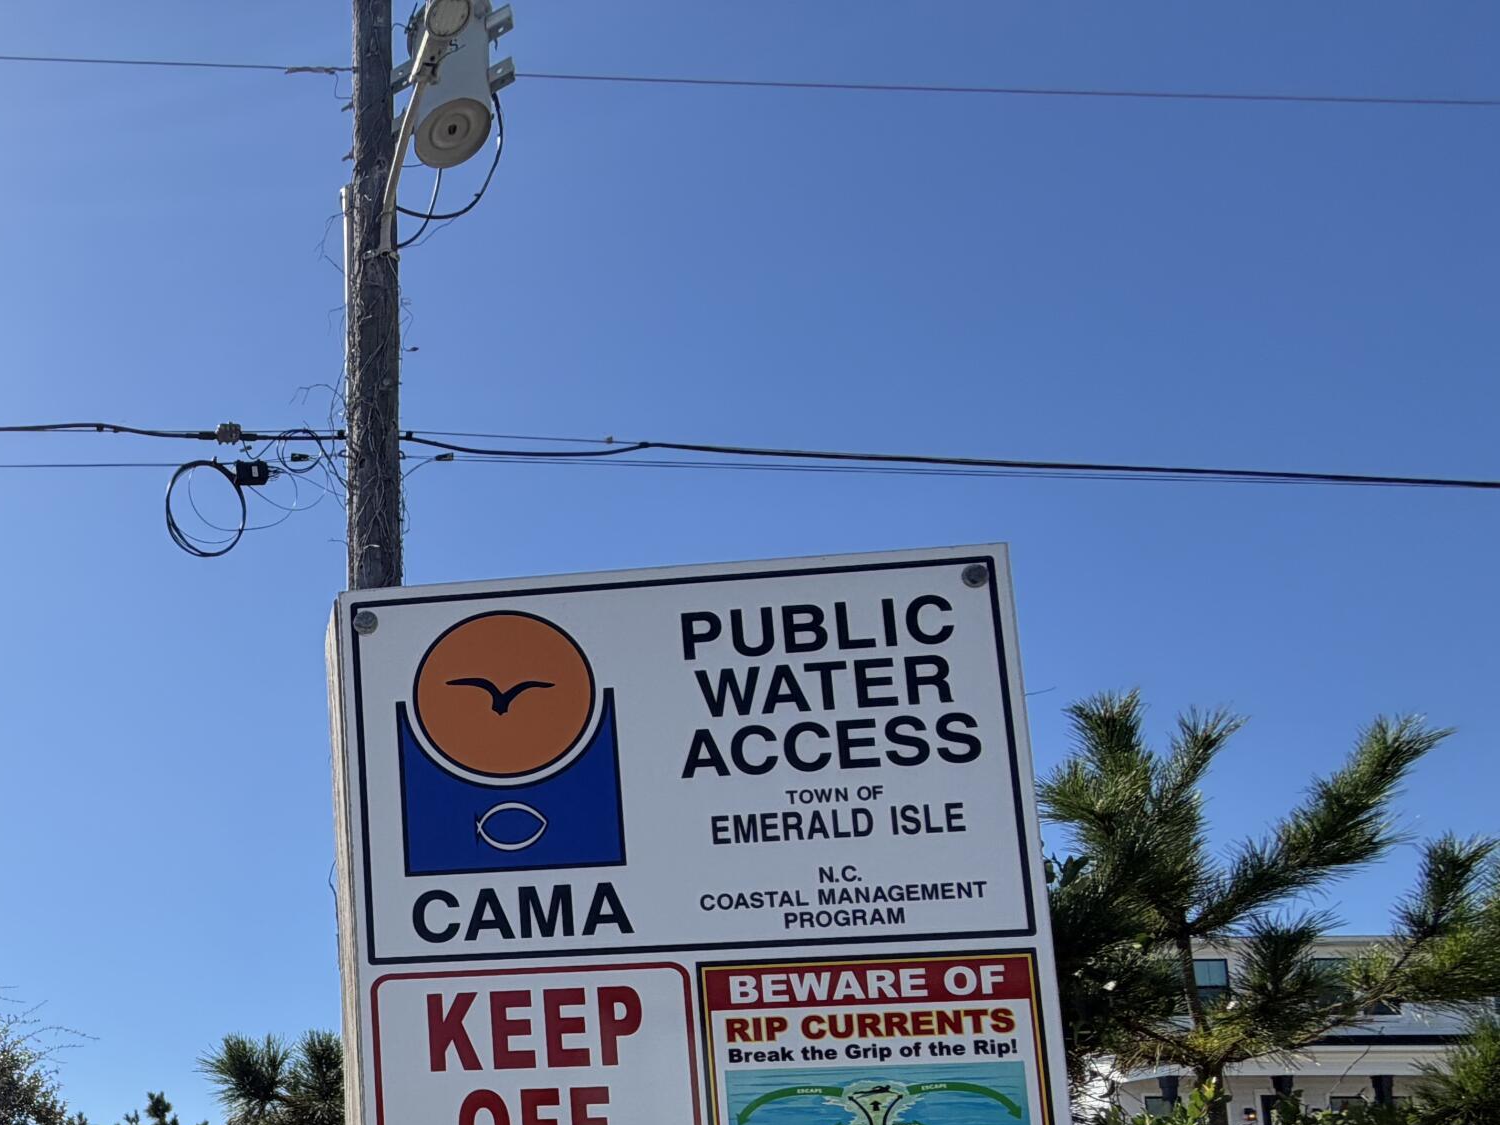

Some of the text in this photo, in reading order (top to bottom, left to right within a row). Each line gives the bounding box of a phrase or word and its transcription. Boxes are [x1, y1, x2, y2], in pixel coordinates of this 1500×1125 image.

[680, 595, 955, 661] PUBLIC
[695, 655, 954, 717] WATER
[681, 713, 981, 779] ACCESS
[786, 785, 883, 804] TOWN OF
[711, 803, 966, 845] EMERALD ISLE
[819, 865, 862, 883] N.C.
[412, 881, 634, 943] CAMA
[700, 881, 987, 911] COASTAL MANAGEMENT
[784, 908, 905, 929] PROGRAM
[729, 965, 1004, 1004] BEWARE OF
[427, 986, 642, 1072] KEEP
[726, 1008, 1015, 1042] RIP CURRENTS
[728, 1039, 1017, 1063] Break the Grip of the Rip!
